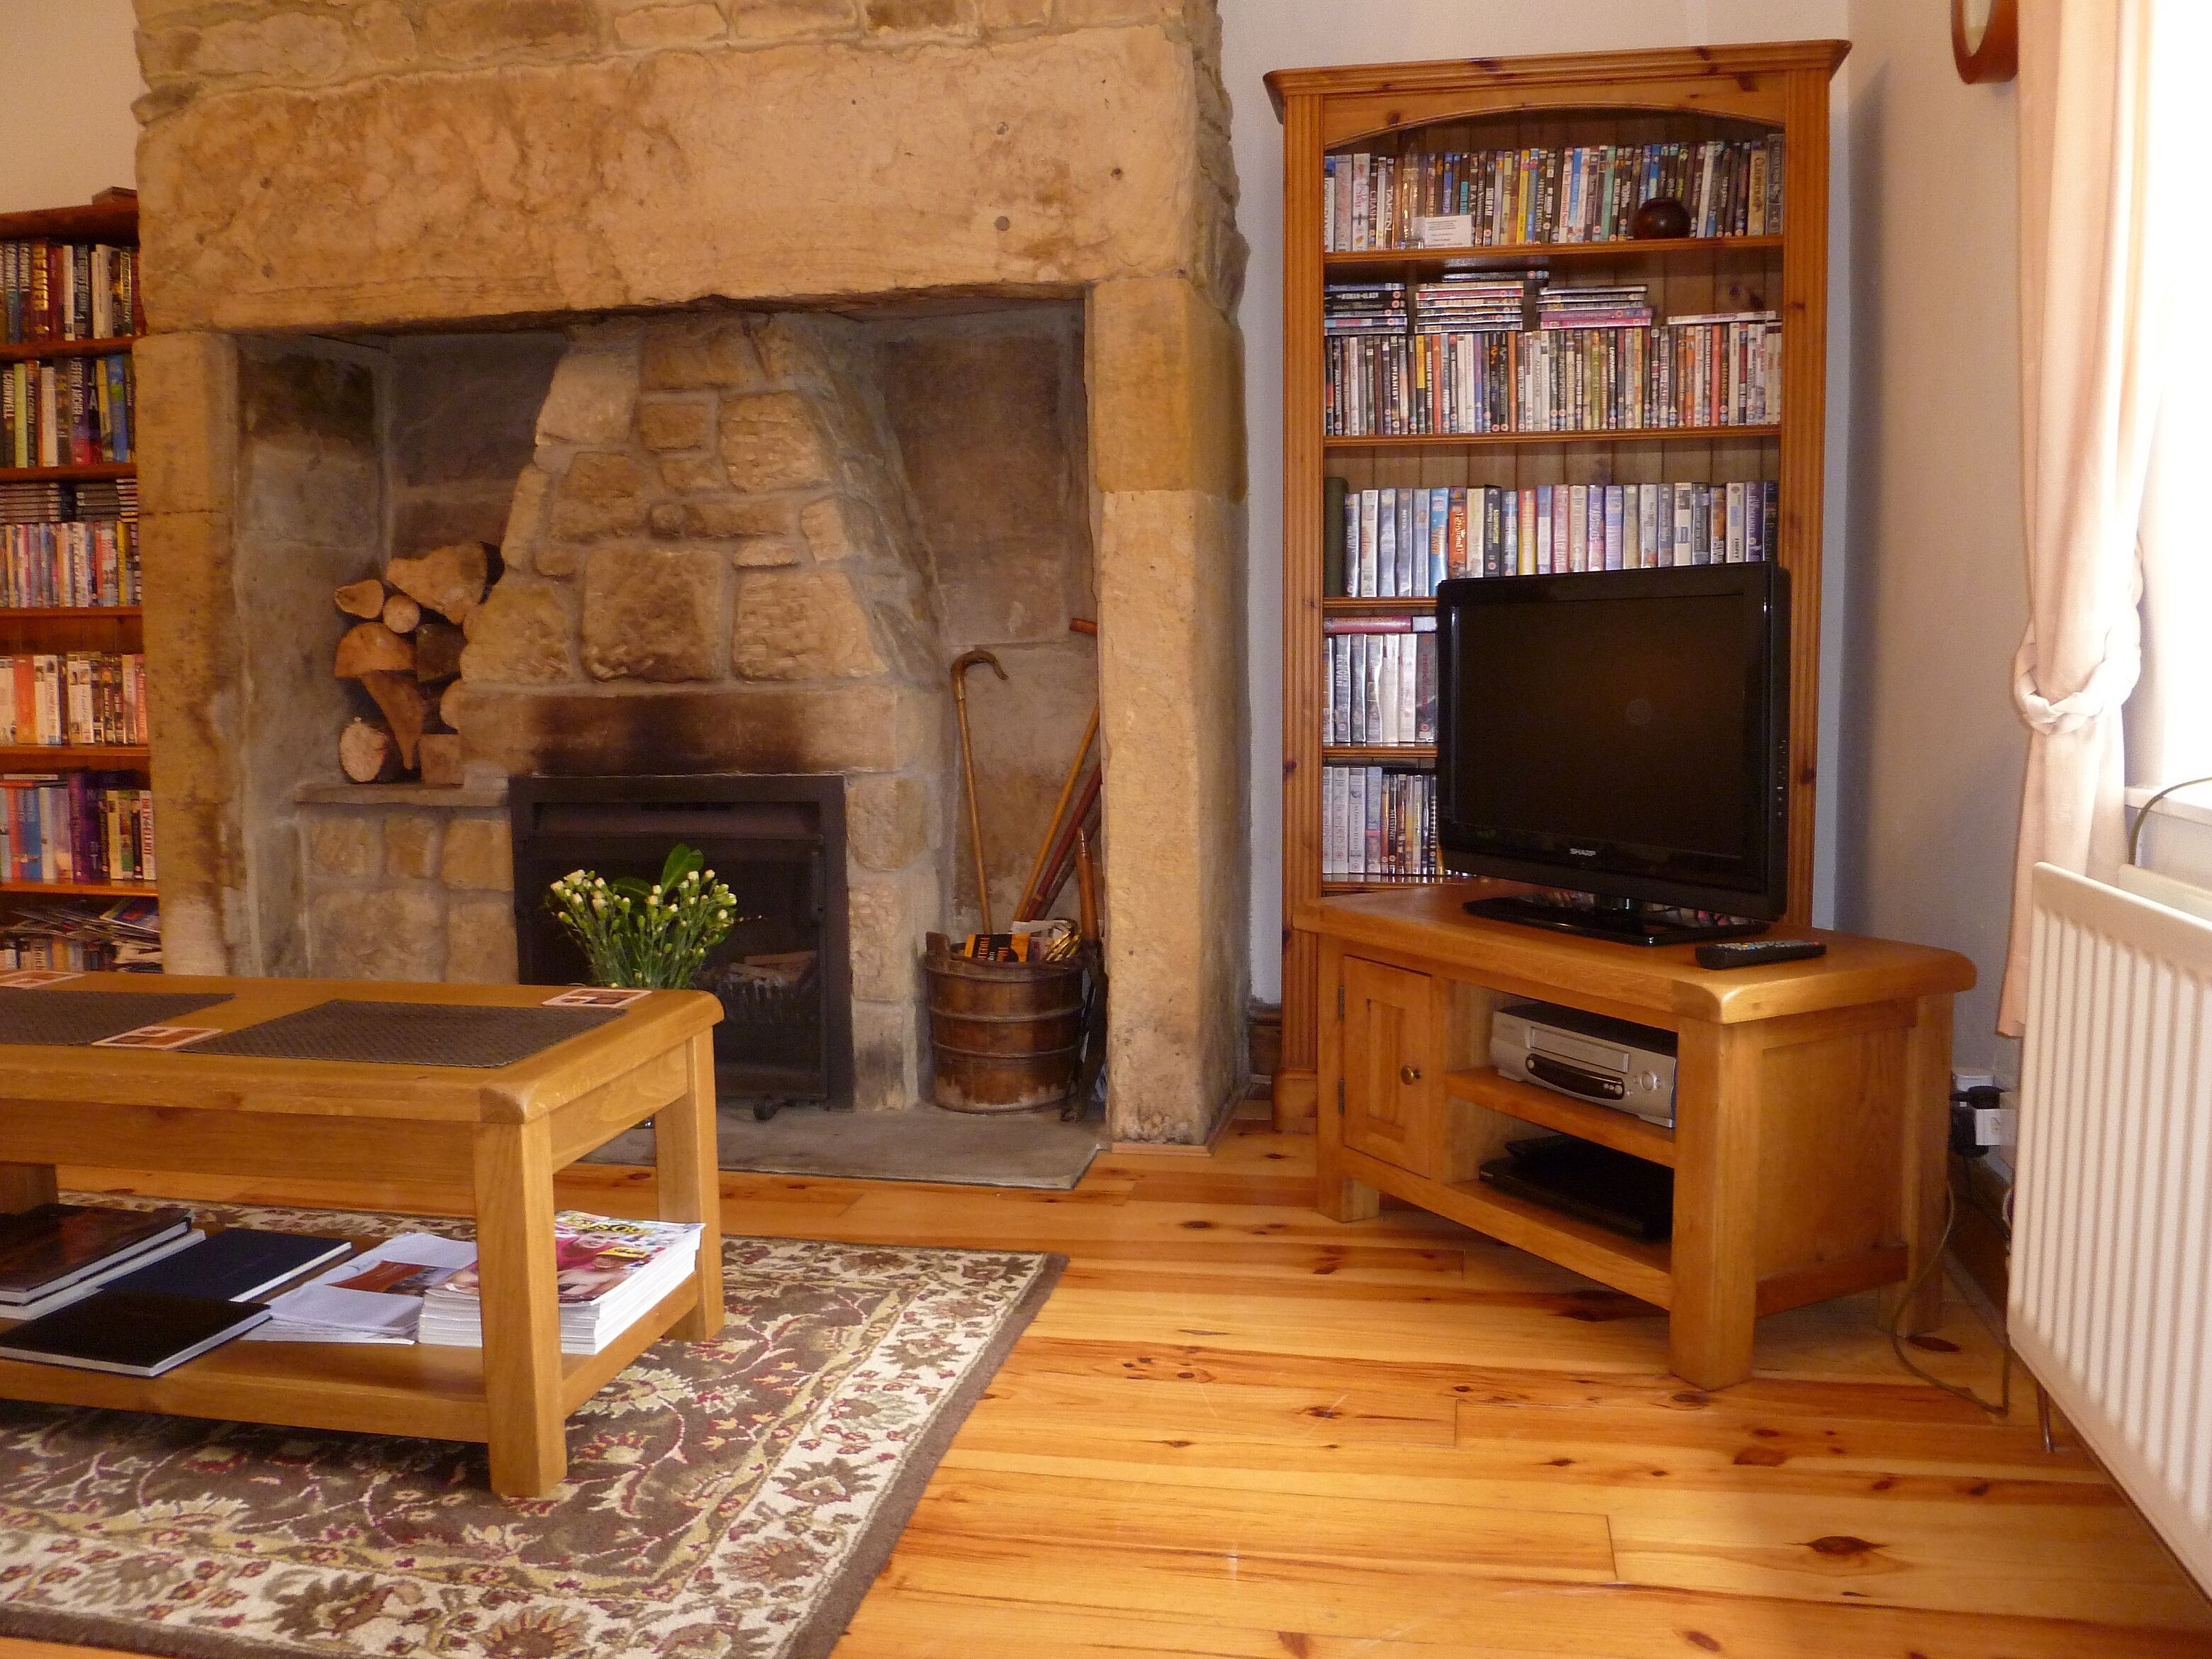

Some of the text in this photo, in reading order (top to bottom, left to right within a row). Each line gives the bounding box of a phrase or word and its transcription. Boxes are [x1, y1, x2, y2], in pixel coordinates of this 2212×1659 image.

[1369, 191, 1378, 220] CRASH
[1385, 186, 1394, 231] TAKEN
[1535, 206, 1543, 232] FUNCTION
[33, 247, 49, 311] DEAVER
[3, 374, 15, 419] CORNWELL
[71, 361, 84, 415] JEFFREY ARCHER
